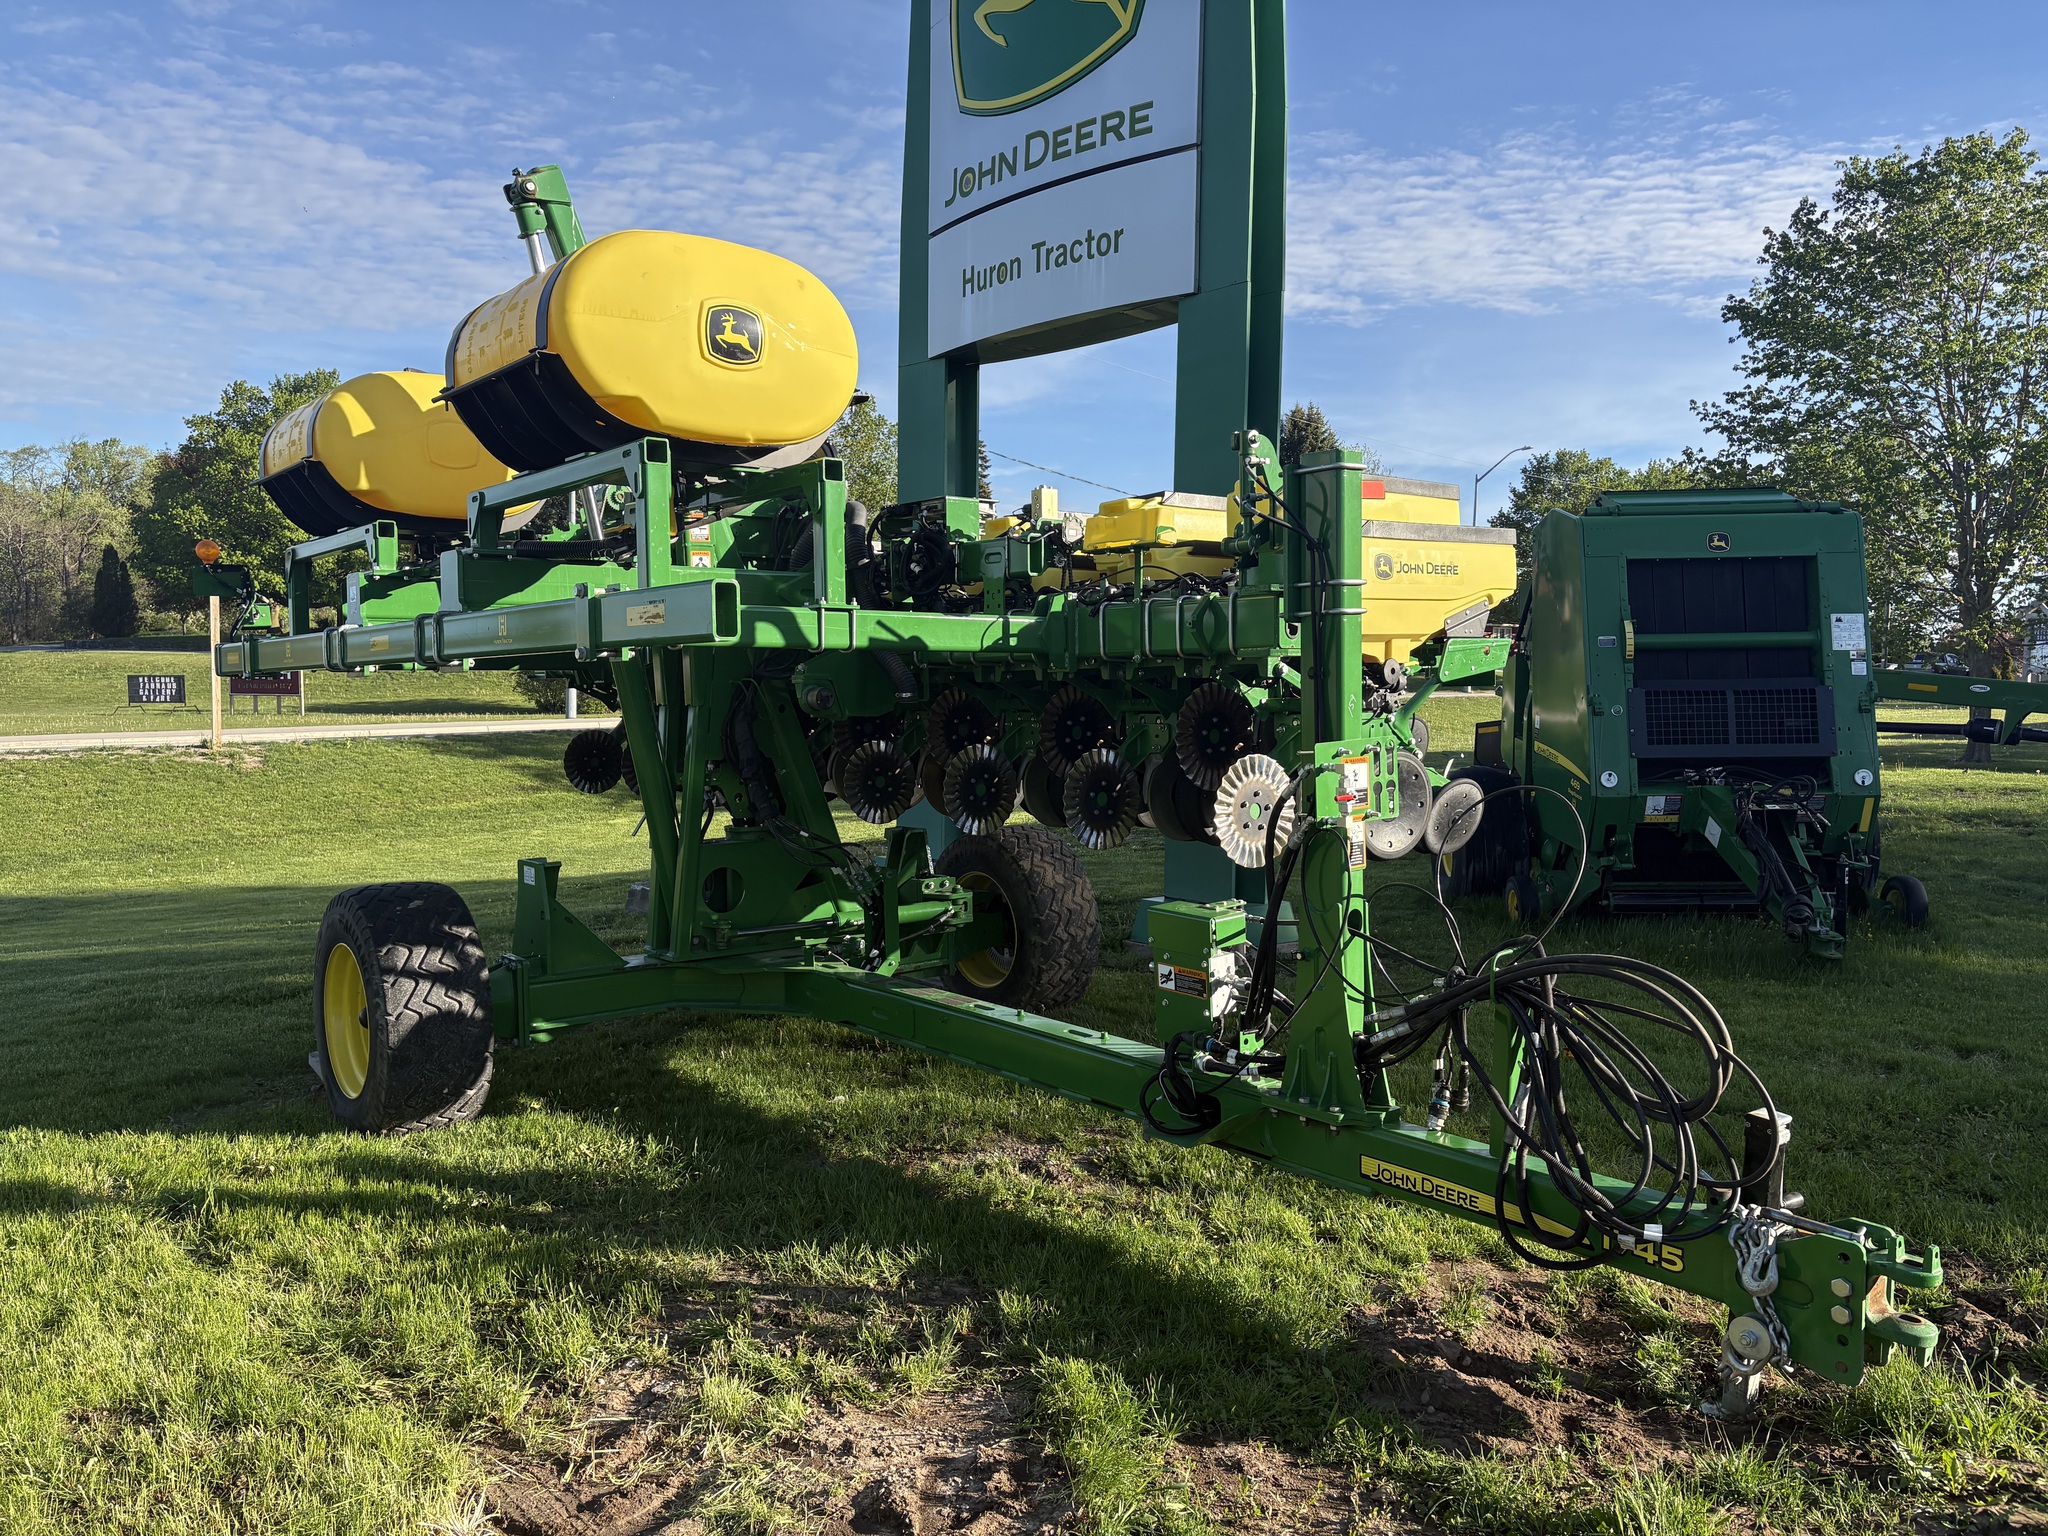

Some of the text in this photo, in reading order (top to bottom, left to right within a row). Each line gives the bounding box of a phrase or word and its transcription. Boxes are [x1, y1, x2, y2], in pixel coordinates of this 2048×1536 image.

[944, 101, 1154, 208] JOHN DEERE
[962, 228, 1124, 298] Huron Tractor
[1396, 560, 1459, 576] JOHN DEERE
[1182, 968, 1203, 978] WARNING
[1371, 1163, 1480, 1210] JOHN DEERE
[1602, 1228, 1684, 1273] 145
